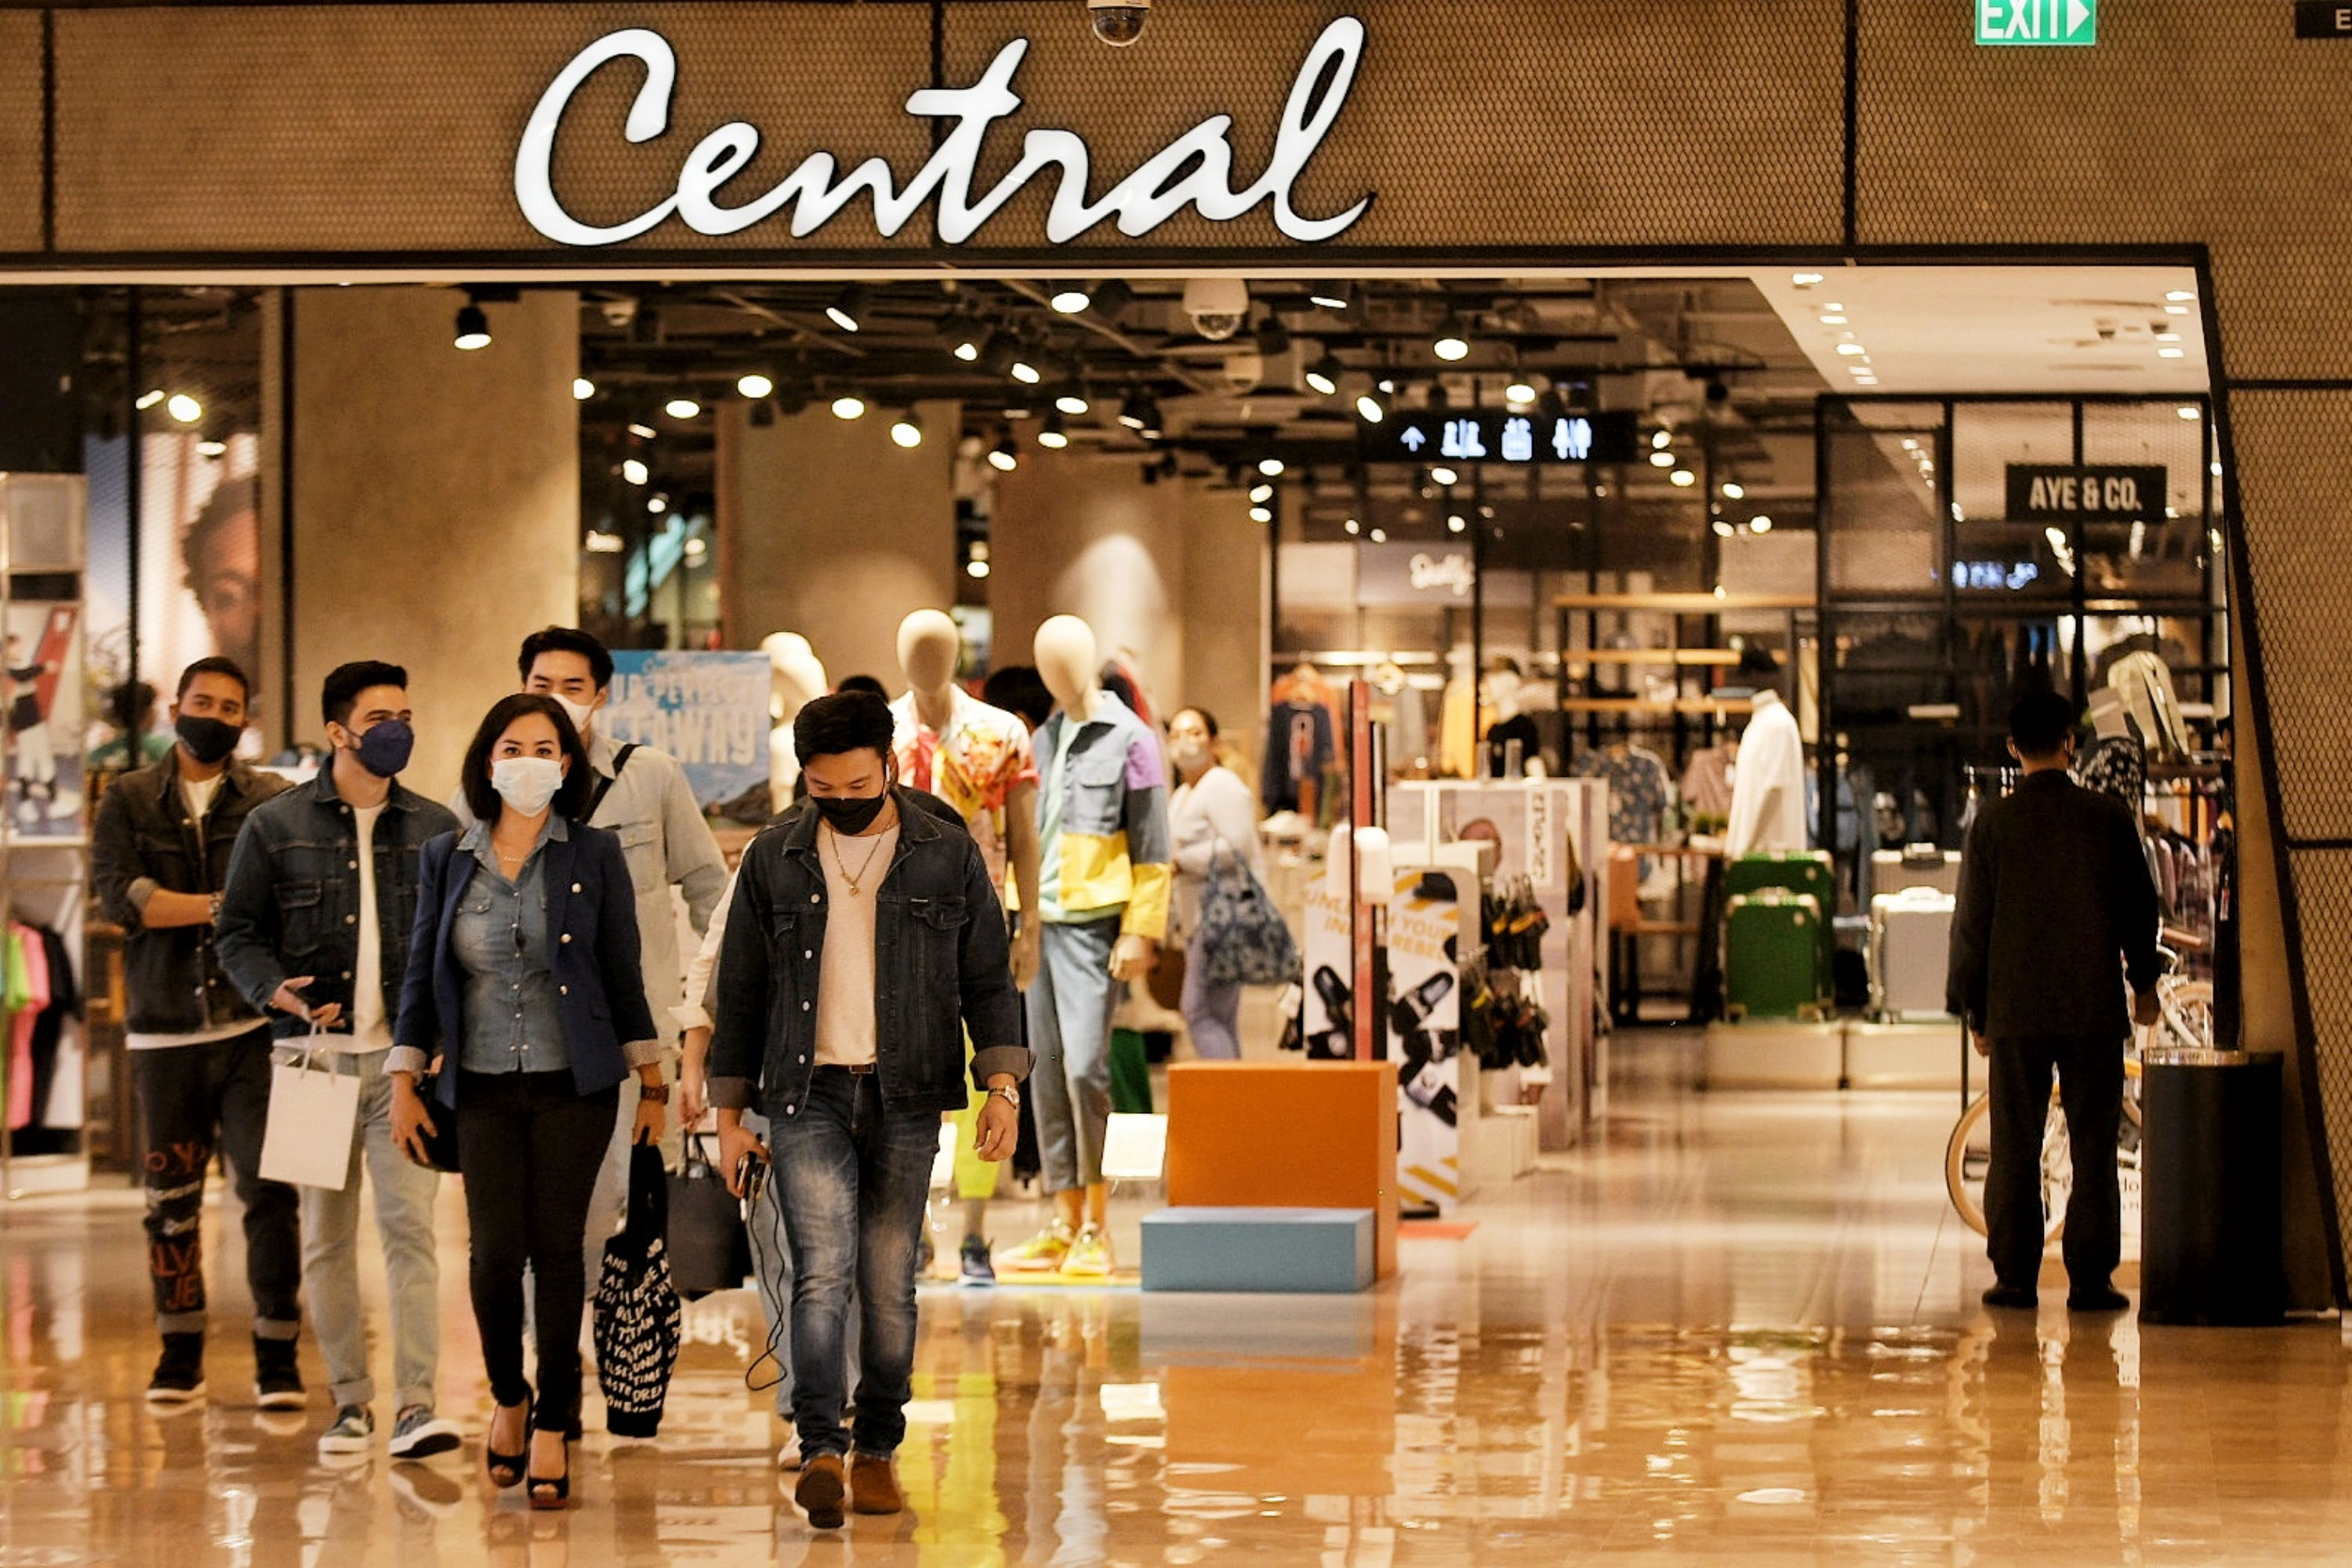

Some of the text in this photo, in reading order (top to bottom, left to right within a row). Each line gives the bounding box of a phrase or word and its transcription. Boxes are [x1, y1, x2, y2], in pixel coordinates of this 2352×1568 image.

[514, 15, 1374, 246] Central
[2029, 477, 2143, 510] AYE & CO.
